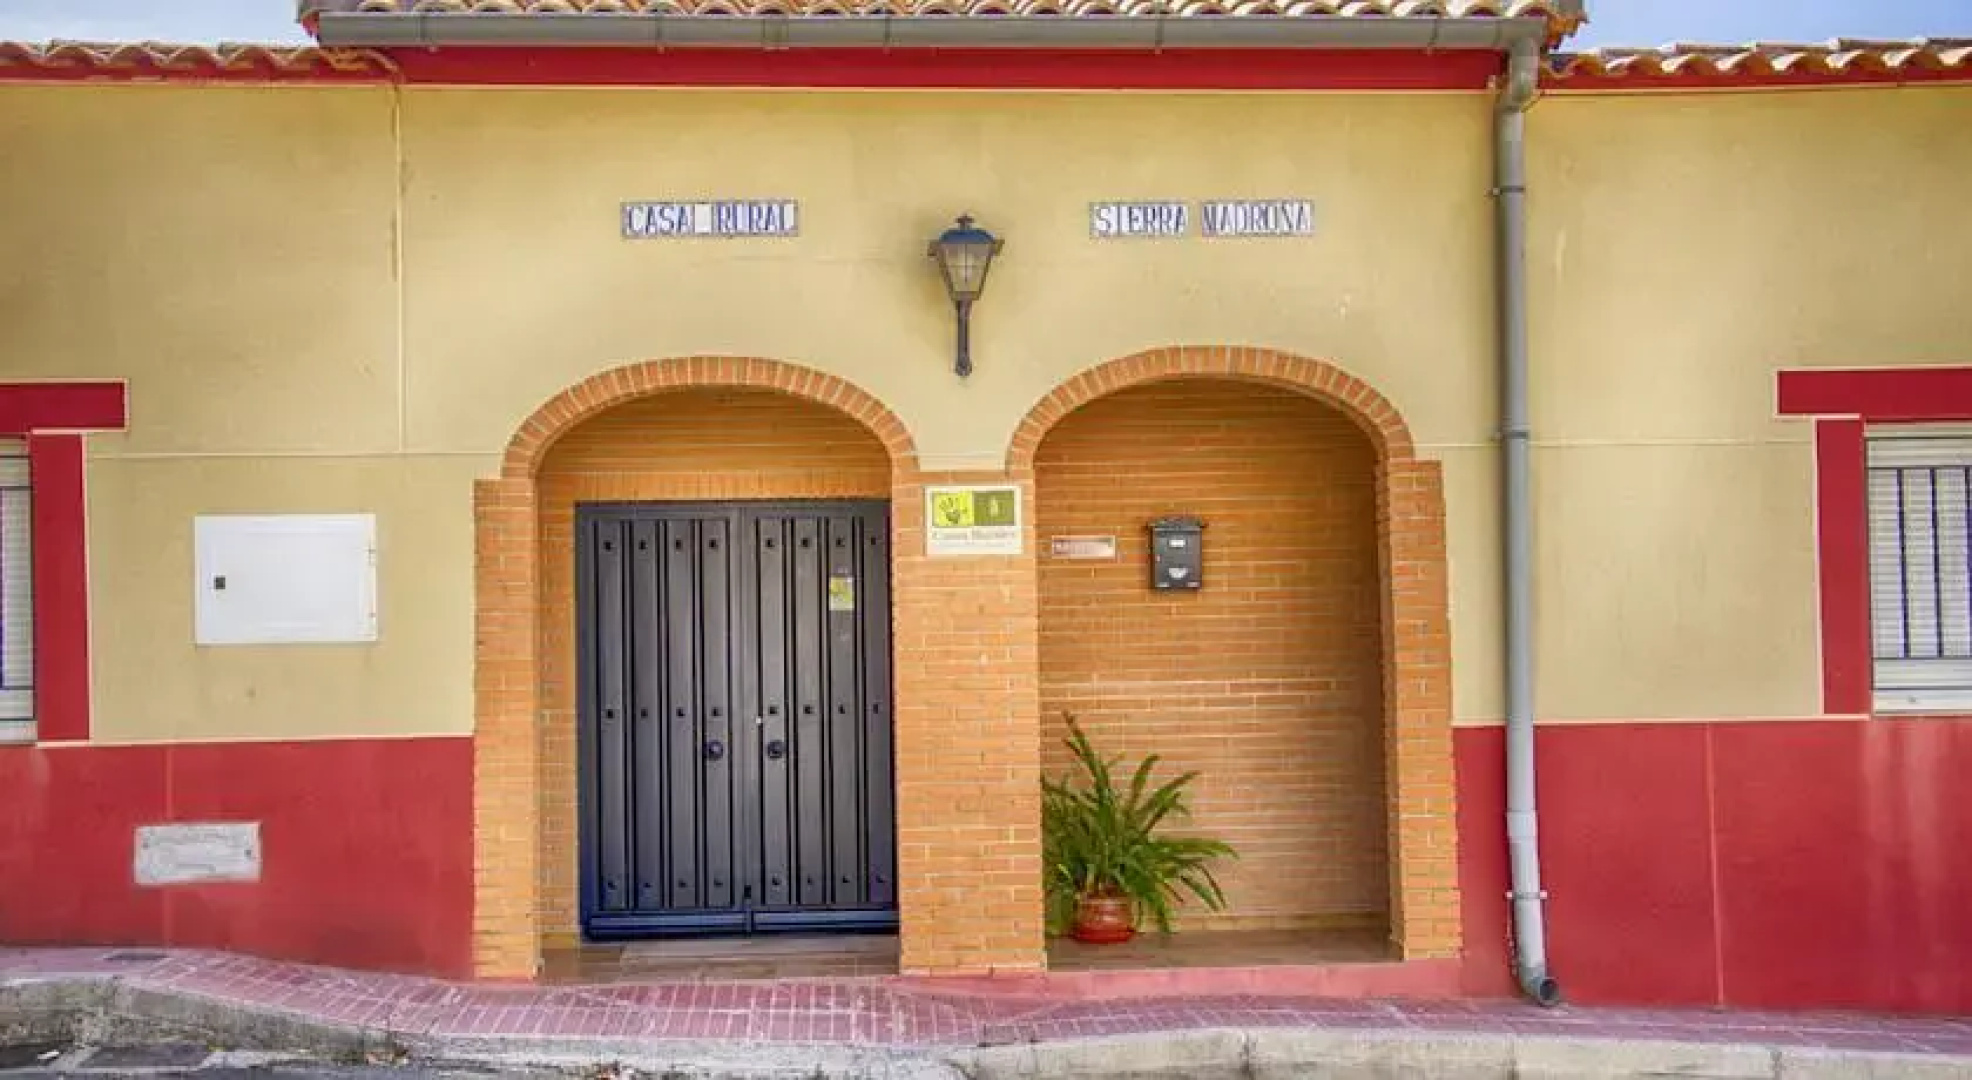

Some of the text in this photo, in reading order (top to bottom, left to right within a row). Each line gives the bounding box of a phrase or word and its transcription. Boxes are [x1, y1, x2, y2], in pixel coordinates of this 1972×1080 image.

[626, 203, 796, 234] CASA RURAL
[1094, 204, 1187, 234] SIERRA
